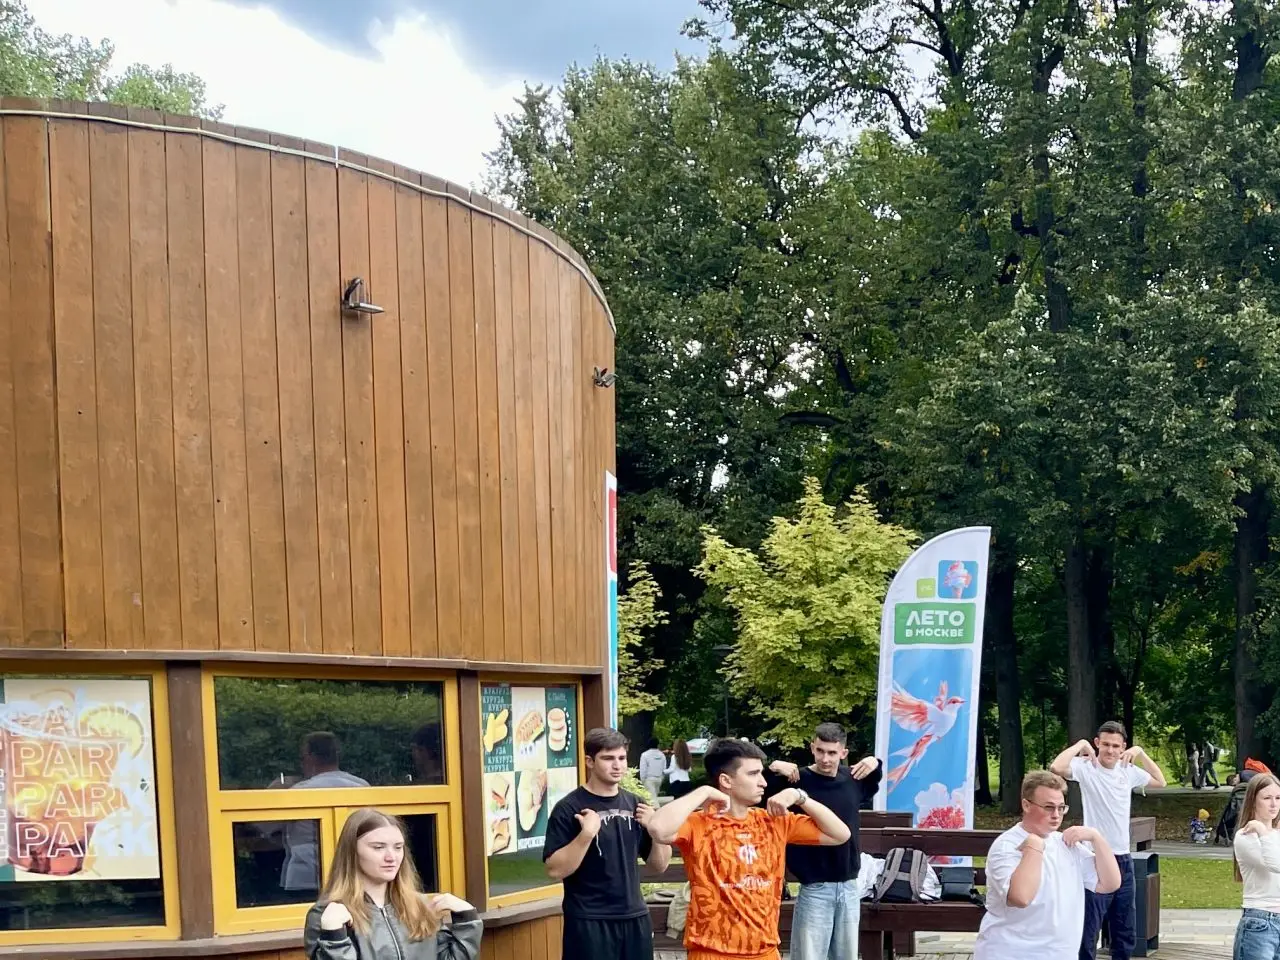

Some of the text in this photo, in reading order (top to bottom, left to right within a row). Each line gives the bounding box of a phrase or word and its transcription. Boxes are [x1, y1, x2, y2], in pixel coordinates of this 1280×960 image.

[906, 609, 965, 626] ЛЕТО
[905, 628, 964, 637] В МОСКВЕ
